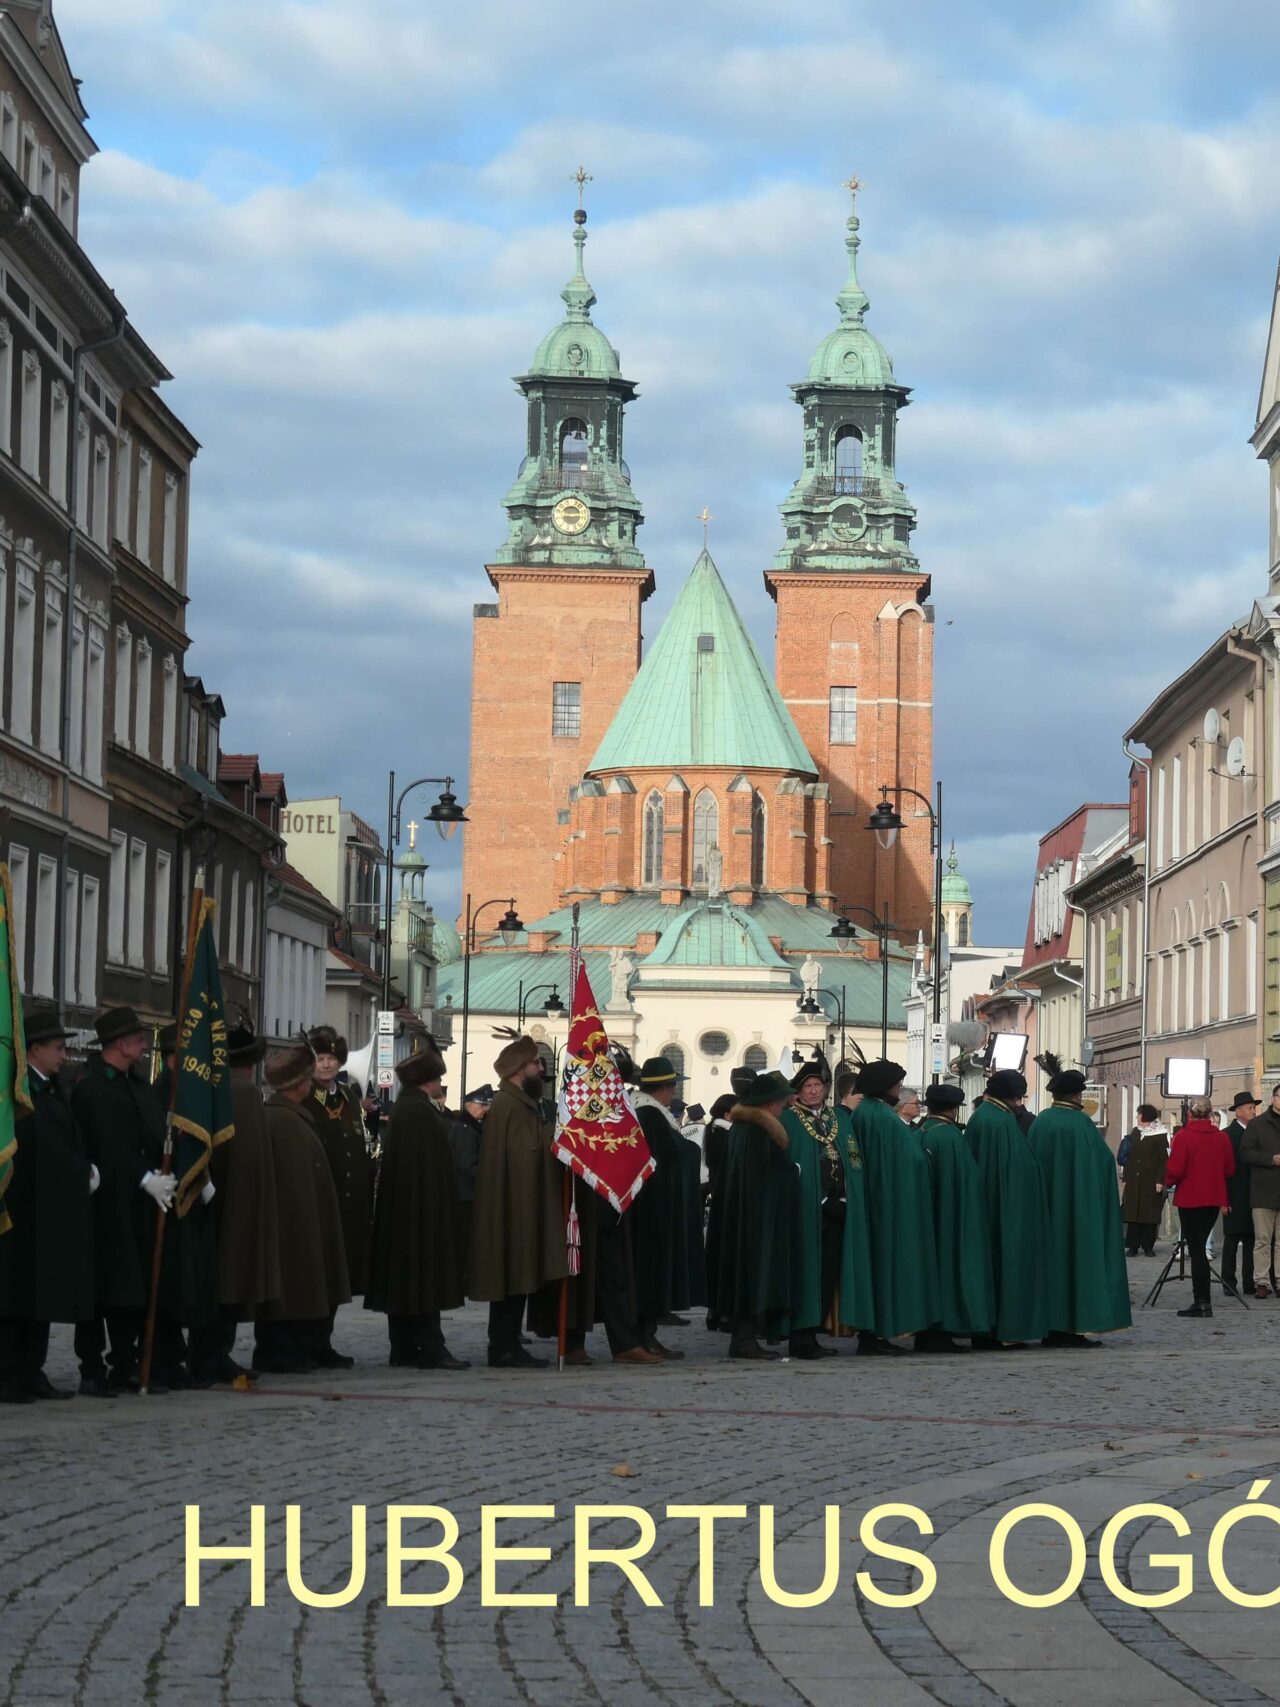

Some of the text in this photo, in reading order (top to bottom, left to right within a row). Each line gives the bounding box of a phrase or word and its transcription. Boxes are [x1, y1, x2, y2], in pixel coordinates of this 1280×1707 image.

[280, 810, 336, 834] HOTEL
[182, 1055, 212, 1081] 1948
[212, 1047, 227, 1067] 64
